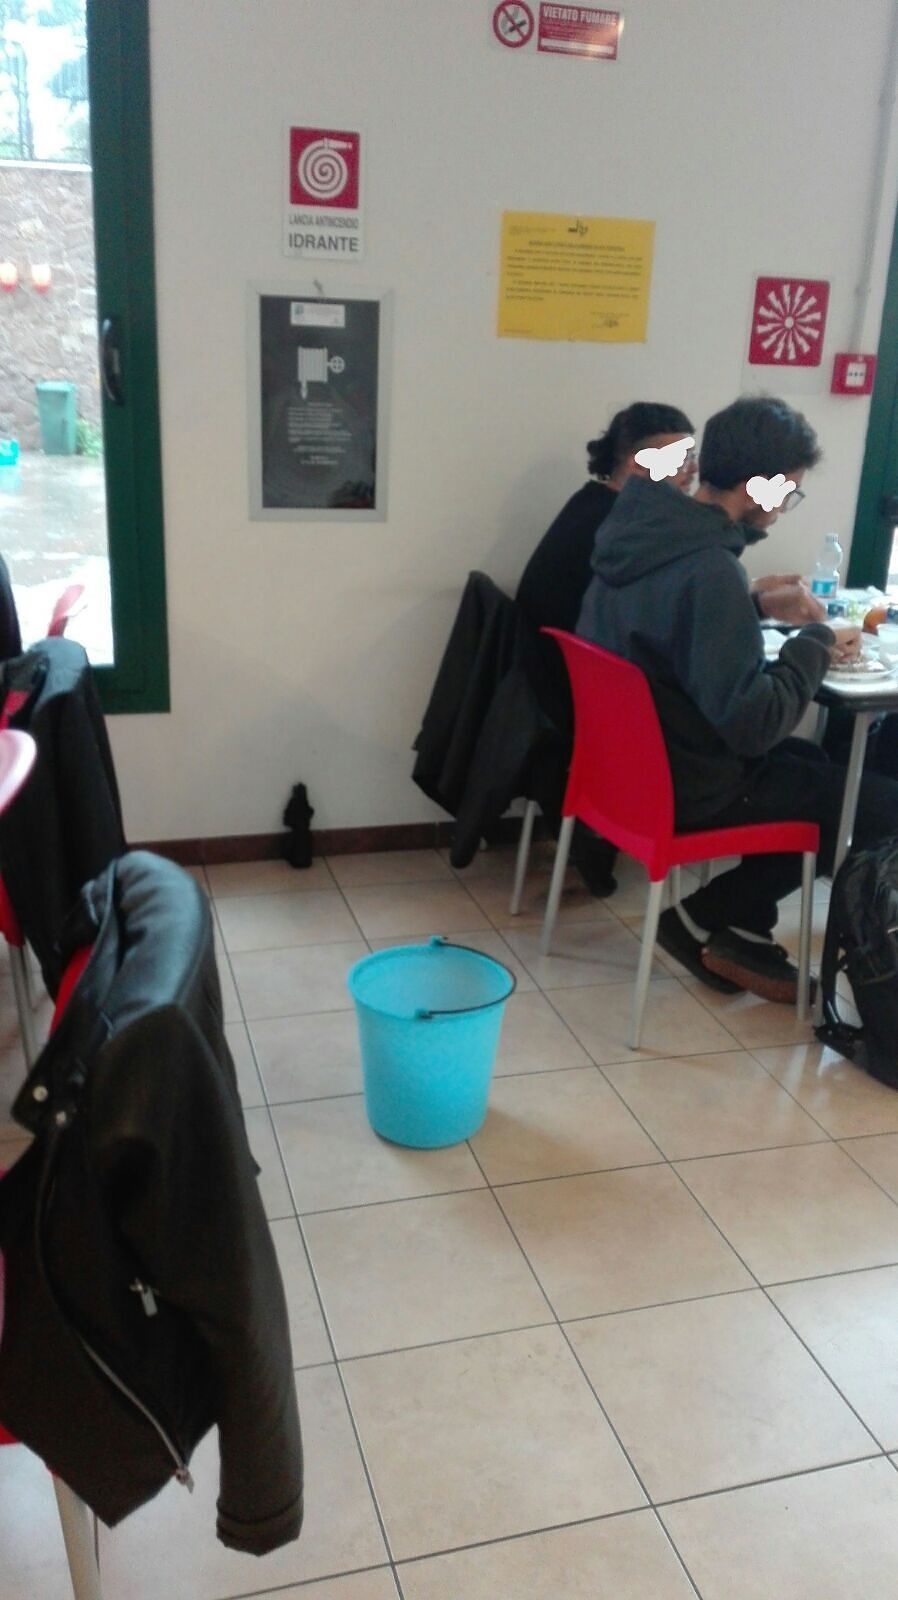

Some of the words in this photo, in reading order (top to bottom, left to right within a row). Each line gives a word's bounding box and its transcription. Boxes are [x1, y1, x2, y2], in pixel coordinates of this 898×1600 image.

[543, 6, 578, 21] VIETATO
[580, 10, 617, 25] FUMARE
[288, 233, 359, 252] IDRANTE
